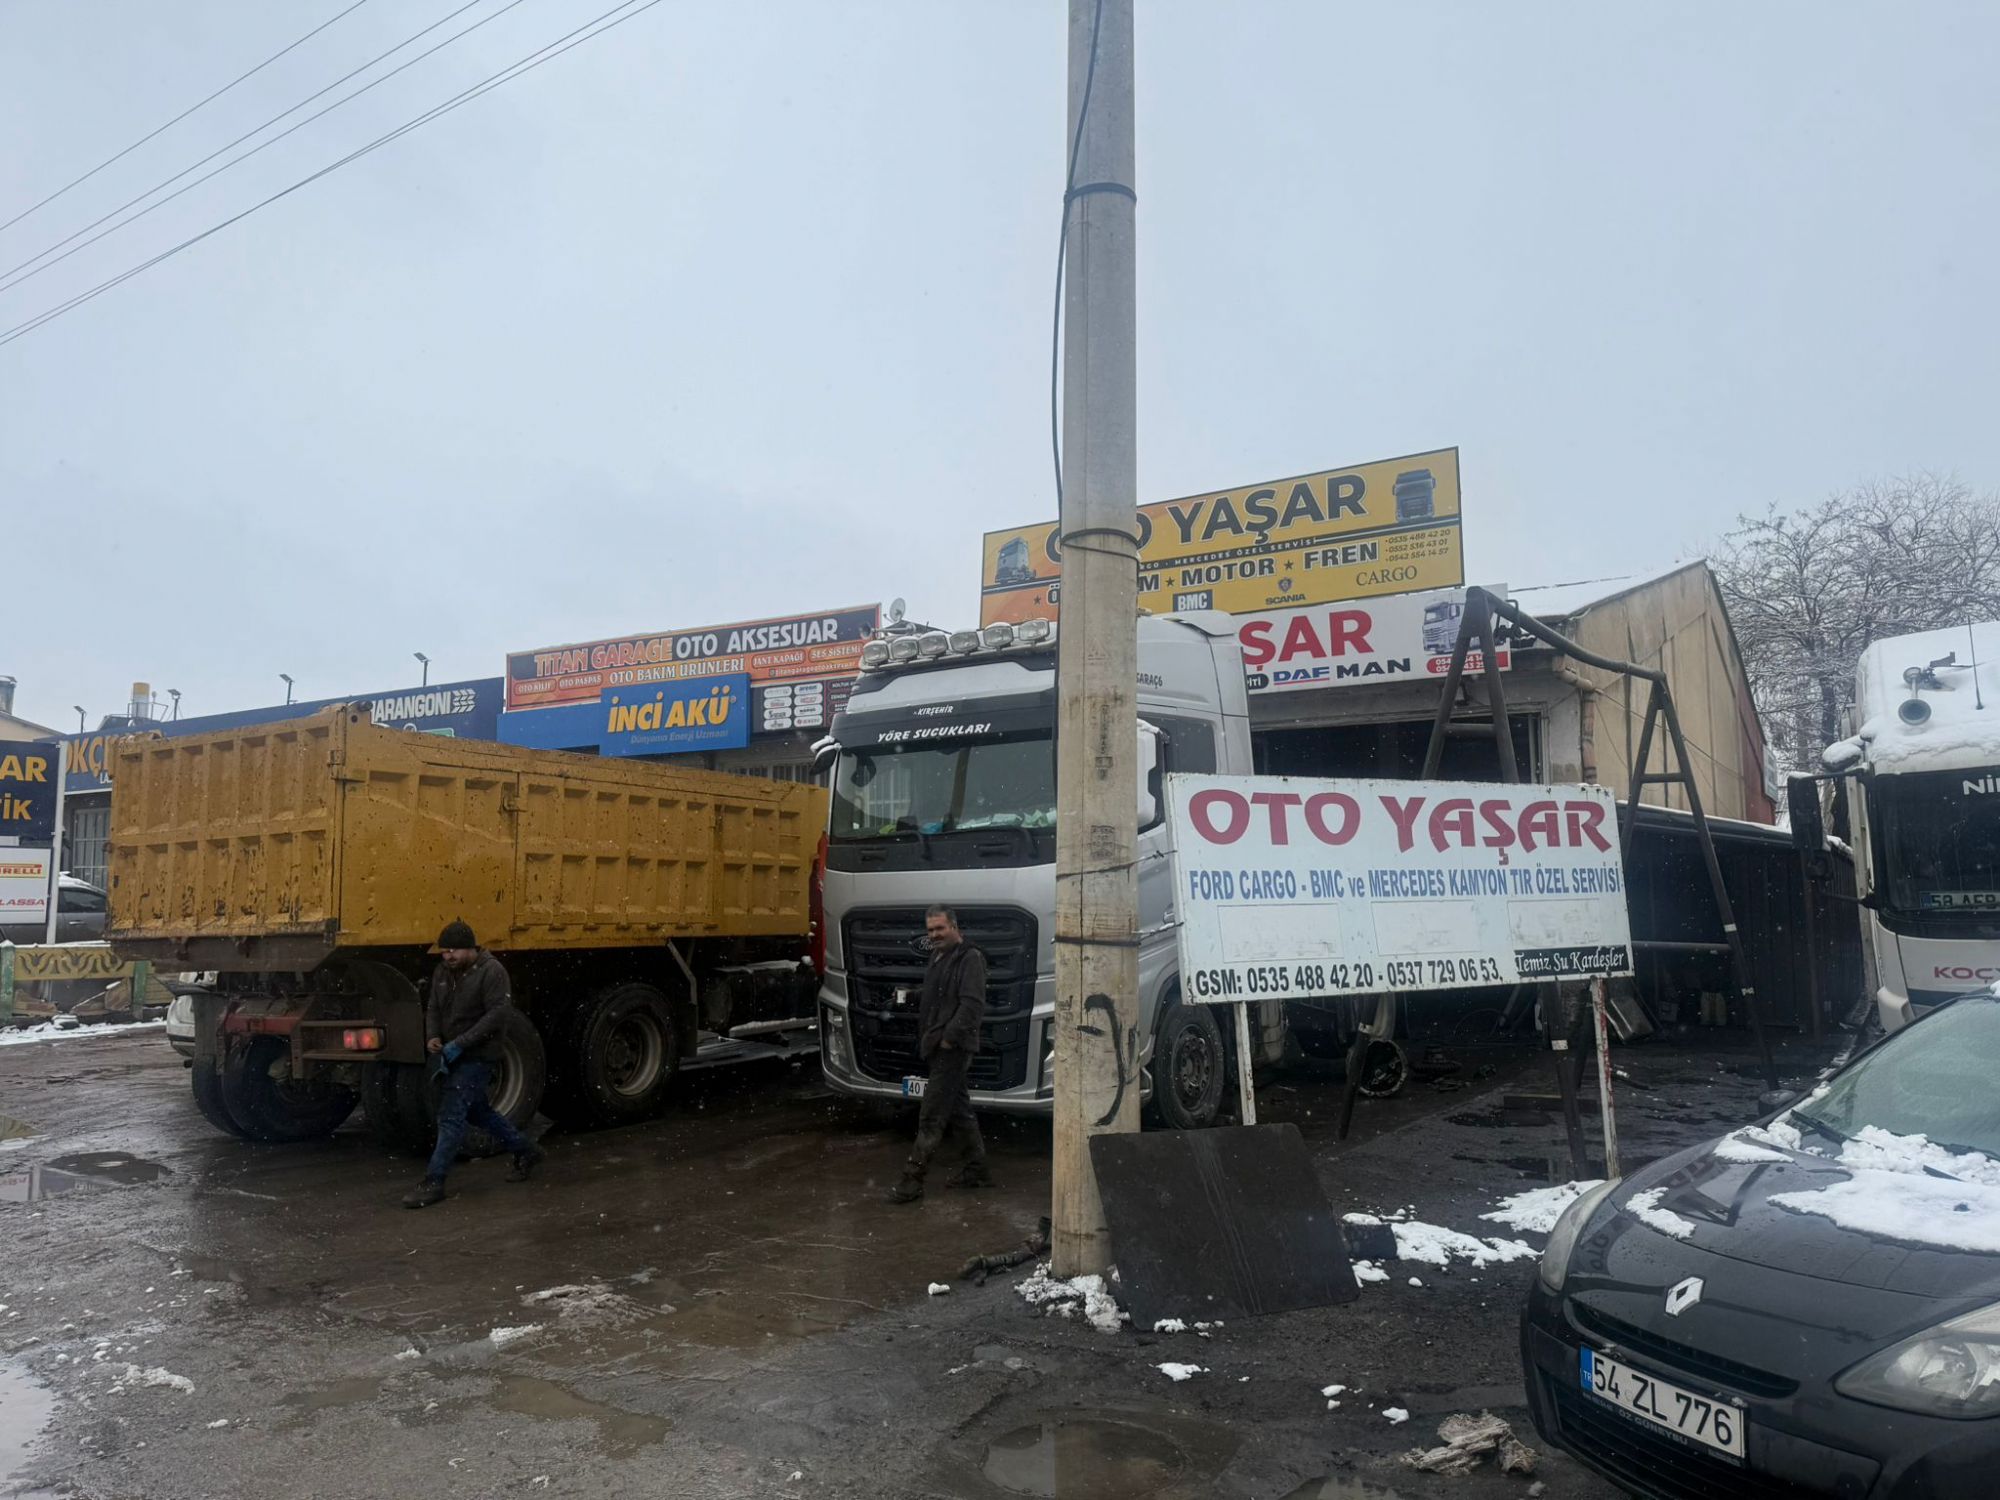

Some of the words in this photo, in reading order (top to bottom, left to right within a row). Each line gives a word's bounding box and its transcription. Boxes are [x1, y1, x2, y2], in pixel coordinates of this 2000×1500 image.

[1168, 474, 1368, 545] YAŞAR
[1175, 552, 1230, 565] MERCEDES
[1237, 545, 1263, 556] ÖZEL
[1270, 537, 1316, 551] SERVİSİ
[1181, 557, 1275, 587] MOTOR
[1304, 542, 1379, 570] FREN
[1356, 566, 1418, 586] CARGO
[1178, 592, 1208, 612] BMC
[1265, 594, 1306, 605] SCANIA
[534, 648, 588, 677] TITAN
[591, 637, 673, 669] GARAGE
[676, 633, 718, 659] OTO
[726, 618, 838, 653] AKSESUAR
[560, 679, 574, 688] OTO
[575, 675, 601, 686] PASPAS
[610, 671, 634, 684] OTO
[637, 665, 676, 682] BAKIM
[680, 655, 745, 678] ÜRÜNLERİ
[1273, 666, 1330, 682] DAF
[1337, 658, 1411, 679] MAN
[607, 691, 664, 733] İNCİ
[664, 685, 730, 729] AKÜ
[918, 705, 954, 716] KIRŞEHİR
[878, 730, 911, 742] YÖRE
[913, 723, 991, 739] SUCUKLARI
[1189, 789, 1361, 845] OTO
[1378, 796, 1612, 865] YAŞAR
[1189, 870, 1234, 900] FORD
[1239, 869, 1297, 899] CARGO
[1309, 869, 1345, 899] BMC
[1348, 878, 1365, 898] ve
[1368, 868, 1446, 898] MERCEDES
[1449, 868, 1508, 896] KAMYON
[1510, 868, 1533, 894] TIR
[1535, 863, 1570, 894] ÖZEL
[1572, 862, 1621, 894] SERVİSİ
[1515, 953, 1551, 973] Temiz
[1553, 952, 1568, 970] Su
[1570, 946, 1625, 972] Kardeşler
[1195, 968, 1243, 996] GSM:
[1247, 966, 1290, 993] 0535
[1295, 965, 1325, 990] 488
[1330, 964, 1350, 988] 42
[1354, 963, 1374, 987] 20
[1386, 958, 1424, 986] 0537
[1428, 959, 1456, 984] 729
[1459, 958, 1477, 982] 06
[1934, 966, 2000, 984] KOÇ
[1583, 1370, 1592, 1383] TR
[1594, 1357, 1620, 1399] 54
[1632, 1373, 1668, 1421] ZL
[1675, 1391, 1732, 1446] 776
